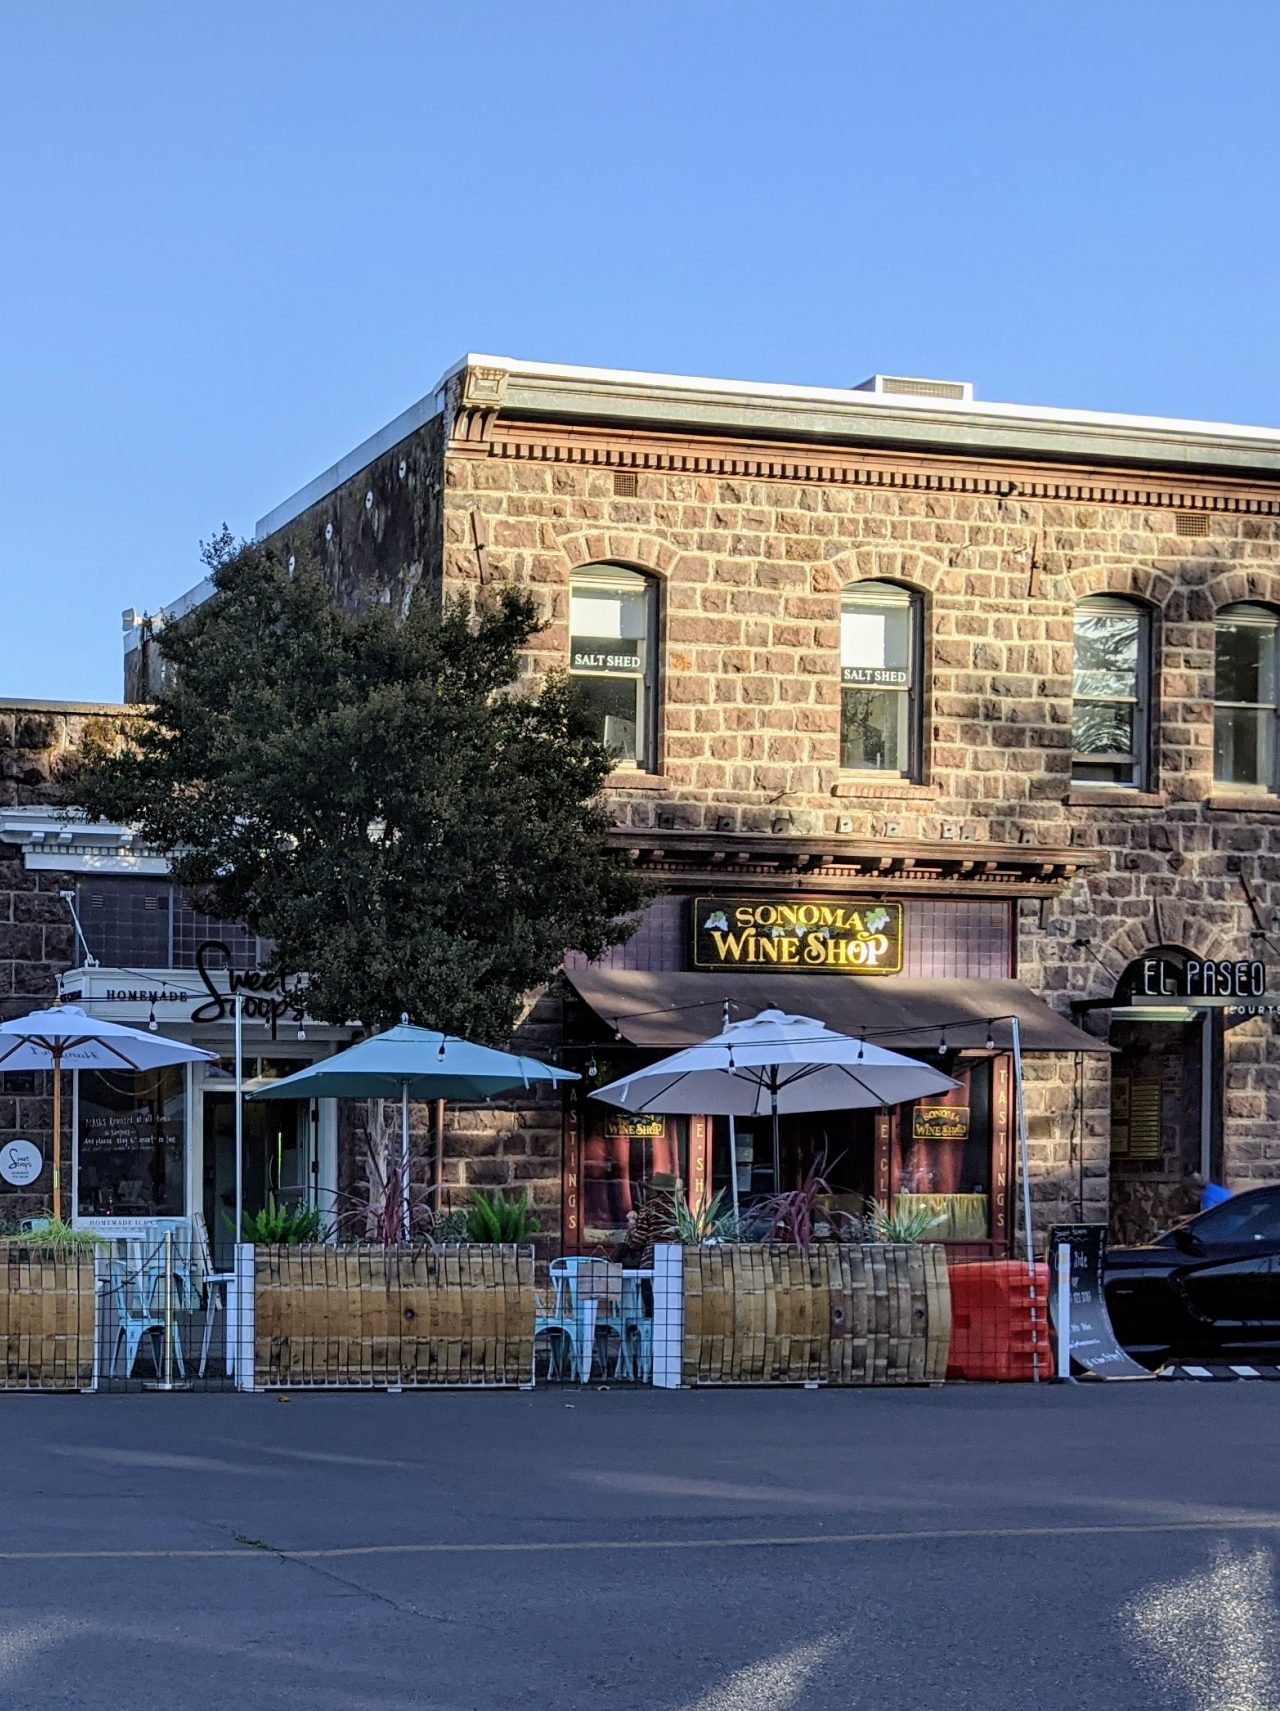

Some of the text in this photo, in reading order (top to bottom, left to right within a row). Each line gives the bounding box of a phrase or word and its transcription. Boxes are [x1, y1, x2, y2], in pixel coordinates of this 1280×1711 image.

[574, 653, 641, 668] SALT SHED
[843, 669, 907, 683] SALT SHED
[734, 904, 865, 931] SONOMA
[710, 927, 890, 965] WINE SHOP
[1143, 959, 1265, 996] EL PASEO
[106, 989, 188, 1003] HOMEMADE
[923, 1109, 960, 1122] SONOMA
[608, 1122, 663, 1136] WINE SHOP
[915, 1123, 941, 1136] WINE
[997, 1069, 1008, 1227] TASTINGS
[568, 1088, 578, 1229] ASTINGS
